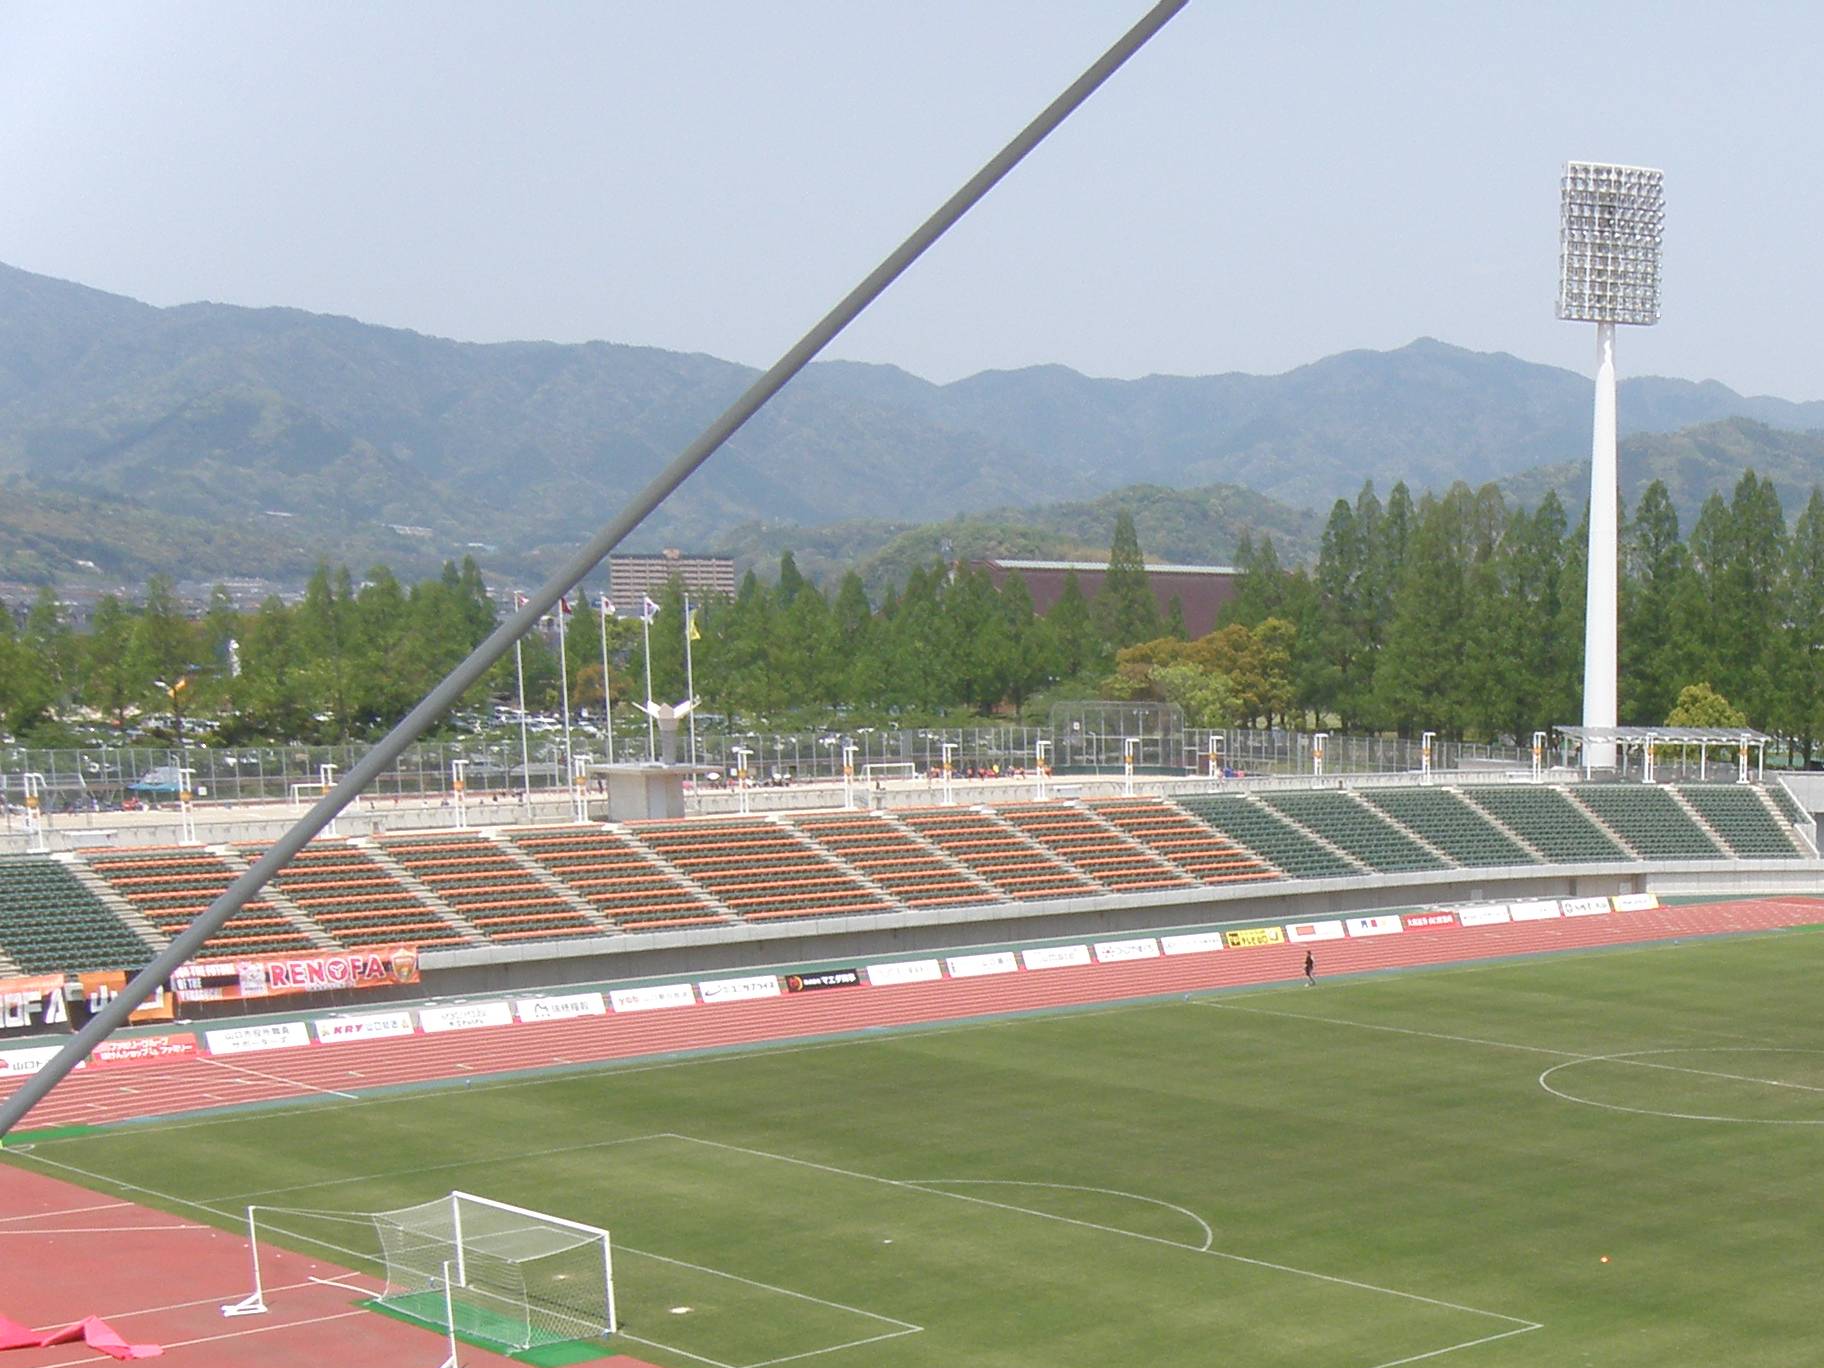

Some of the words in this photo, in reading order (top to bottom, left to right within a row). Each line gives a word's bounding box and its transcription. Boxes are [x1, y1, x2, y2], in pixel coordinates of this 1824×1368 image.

[269, 954, 386, 988] RENOFA
[0, 987, 68, 1028] OFA
[333, 1024, 363, 1034] KRY
